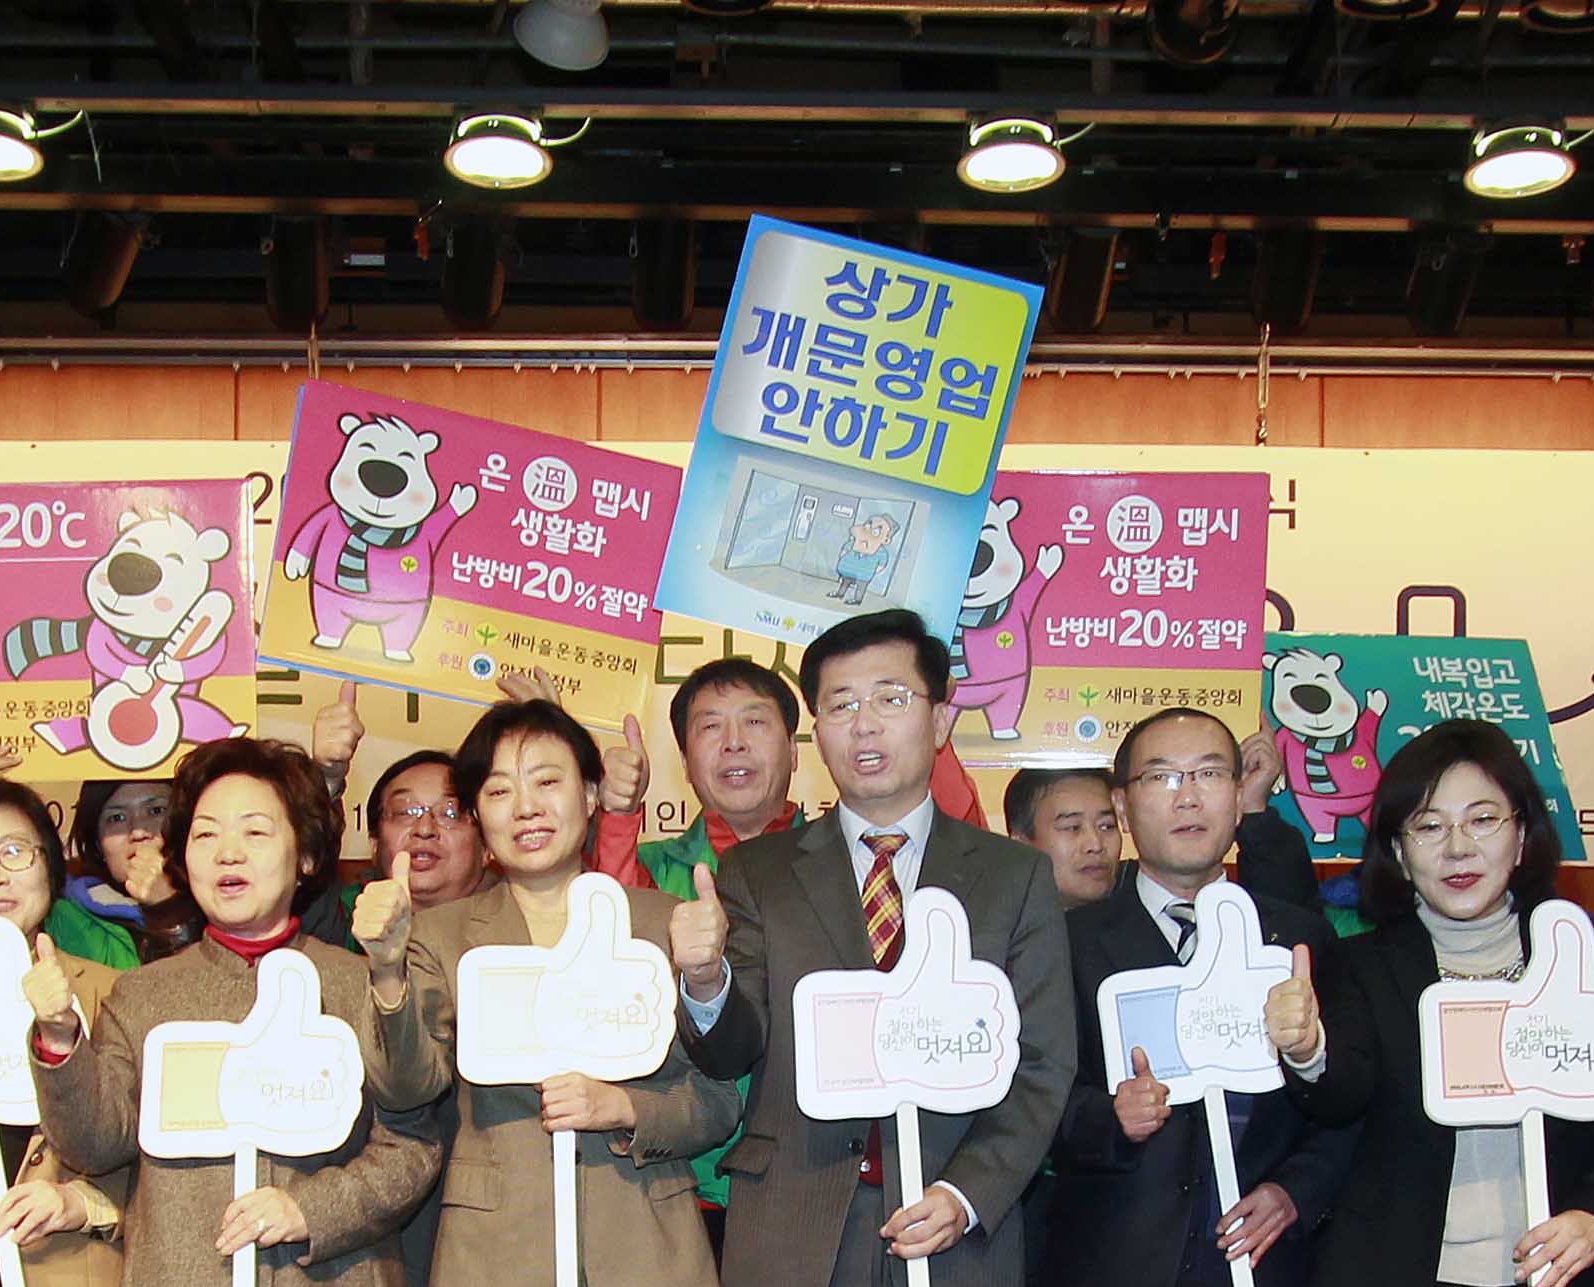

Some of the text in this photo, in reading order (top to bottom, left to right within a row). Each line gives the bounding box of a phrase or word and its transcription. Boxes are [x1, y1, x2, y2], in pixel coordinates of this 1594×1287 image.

[824, 261, 954, 340] 상가
[741, 305, 999, 421] 개문영업
[758, 381, 950, 478] 안하기
[478, 453, 511, 494] 온
[590, 477, 653, 521] 맵시
[511, 506, 607, 558] 생활화
[1061, 504, 1096, 545] 온
[1176, 506, 1240, 547] 맵시
[1099, 555, 1199, 596] 생활화
[1412, 655, 1521, 689] 내복입고
[1105, 686, 1242, 707] 새마을운동중앙회
[1421, 689, 1530, 723] 체감온도
[917, 1030, 992, 1064] 멋져요
[1218, 1015, 1268, 1050] 멋져
